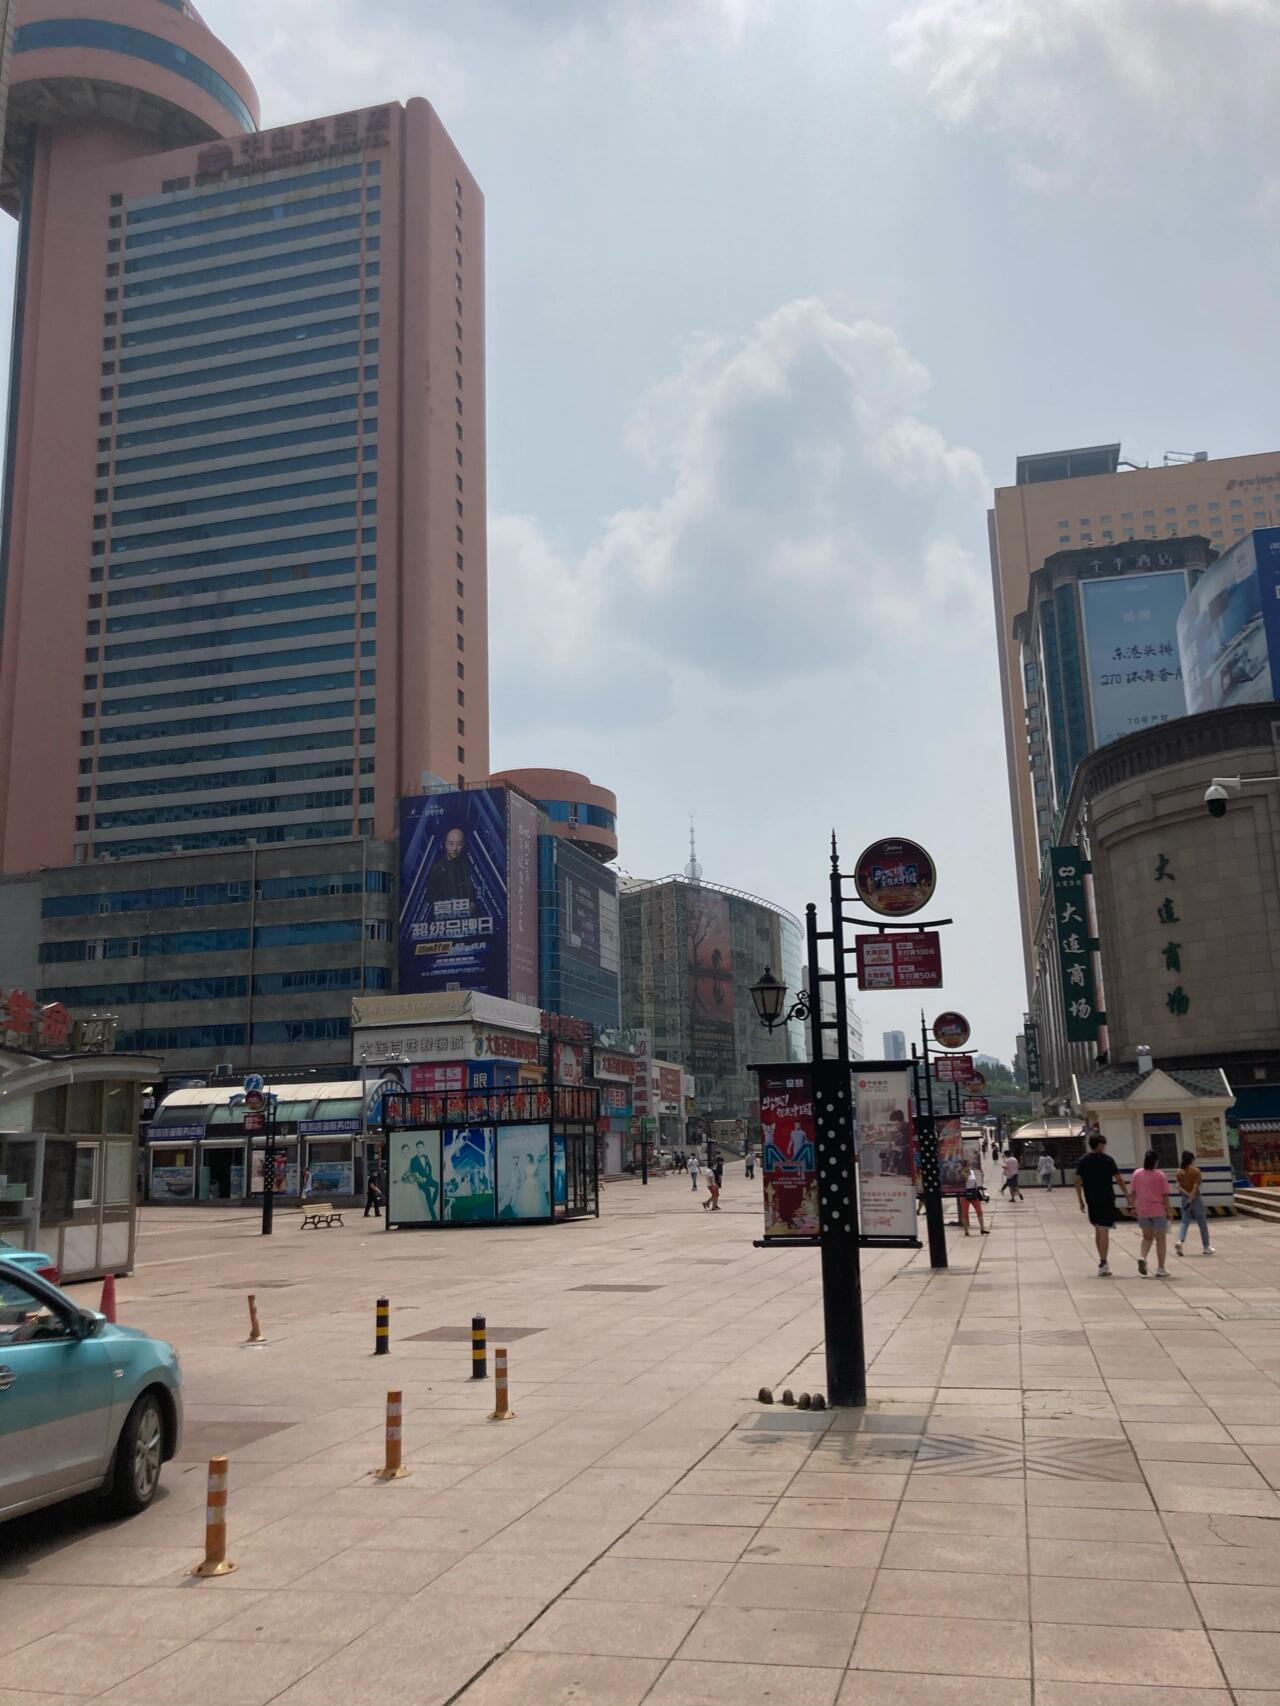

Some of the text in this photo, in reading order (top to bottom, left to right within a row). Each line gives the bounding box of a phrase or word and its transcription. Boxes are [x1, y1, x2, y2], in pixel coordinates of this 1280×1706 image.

[411, 917, 494, 939] 超级品牌日
[1060, 902, 1092, 1020] 大连商场
